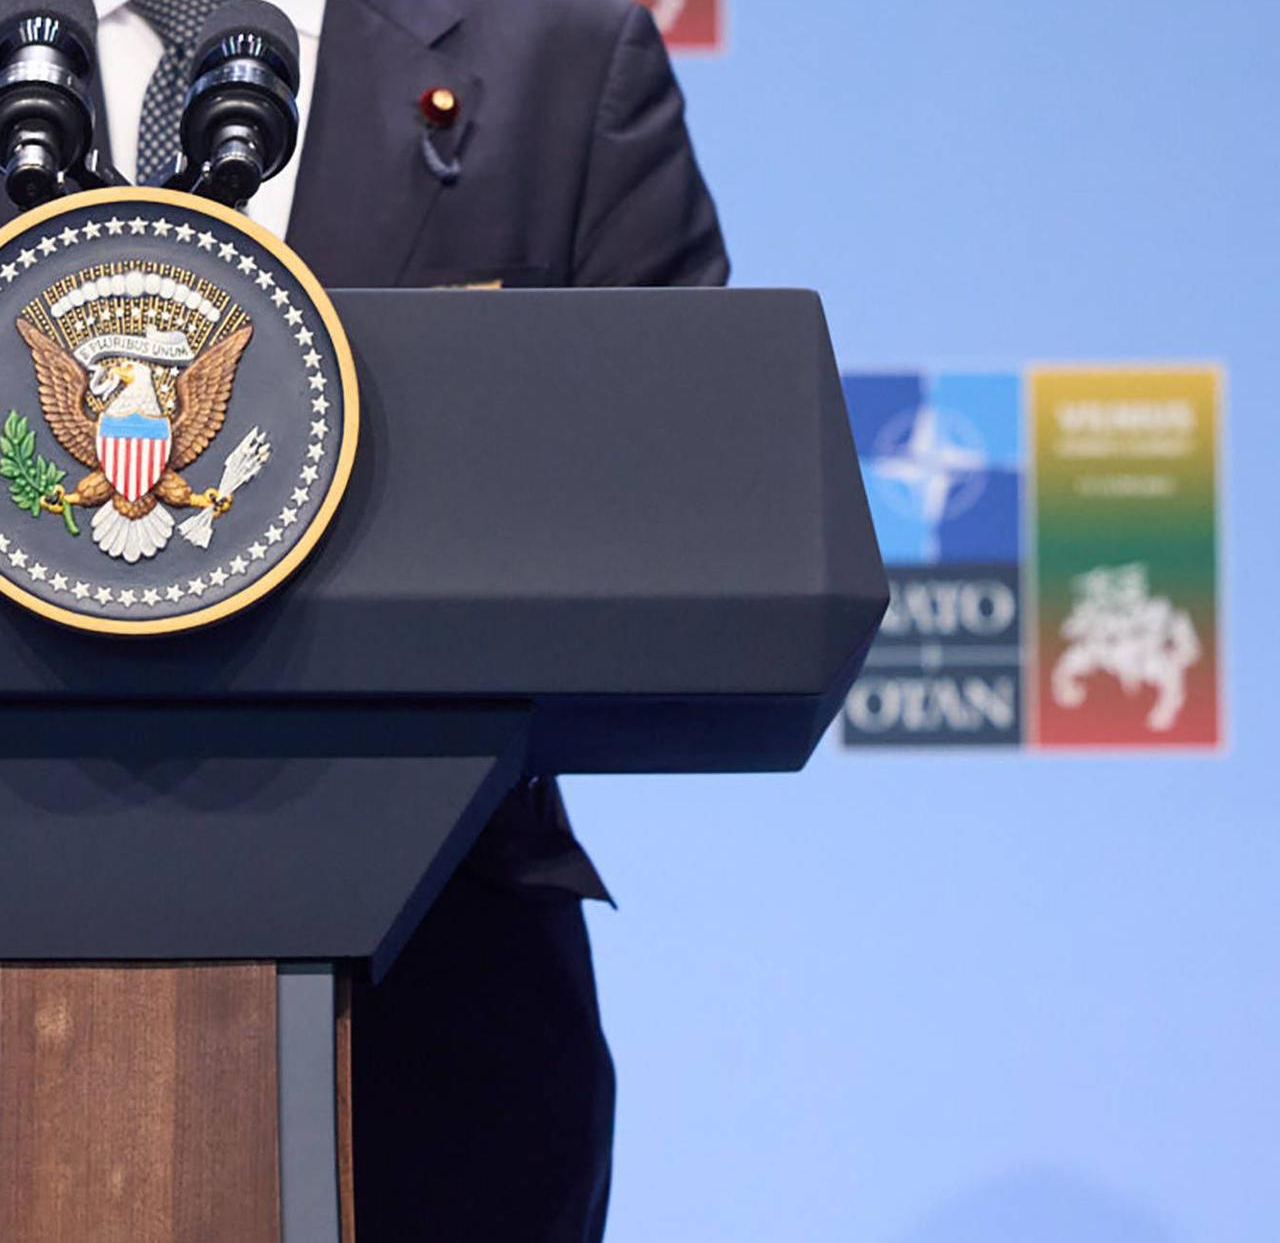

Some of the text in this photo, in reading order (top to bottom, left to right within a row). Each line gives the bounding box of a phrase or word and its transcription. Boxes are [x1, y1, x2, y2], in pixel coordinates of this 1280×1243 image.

[89, 336, 151, 354] PLURIBUS
[151, 344, 188, 357] UNUM
[845, 675, 1015, 732] OTAN
